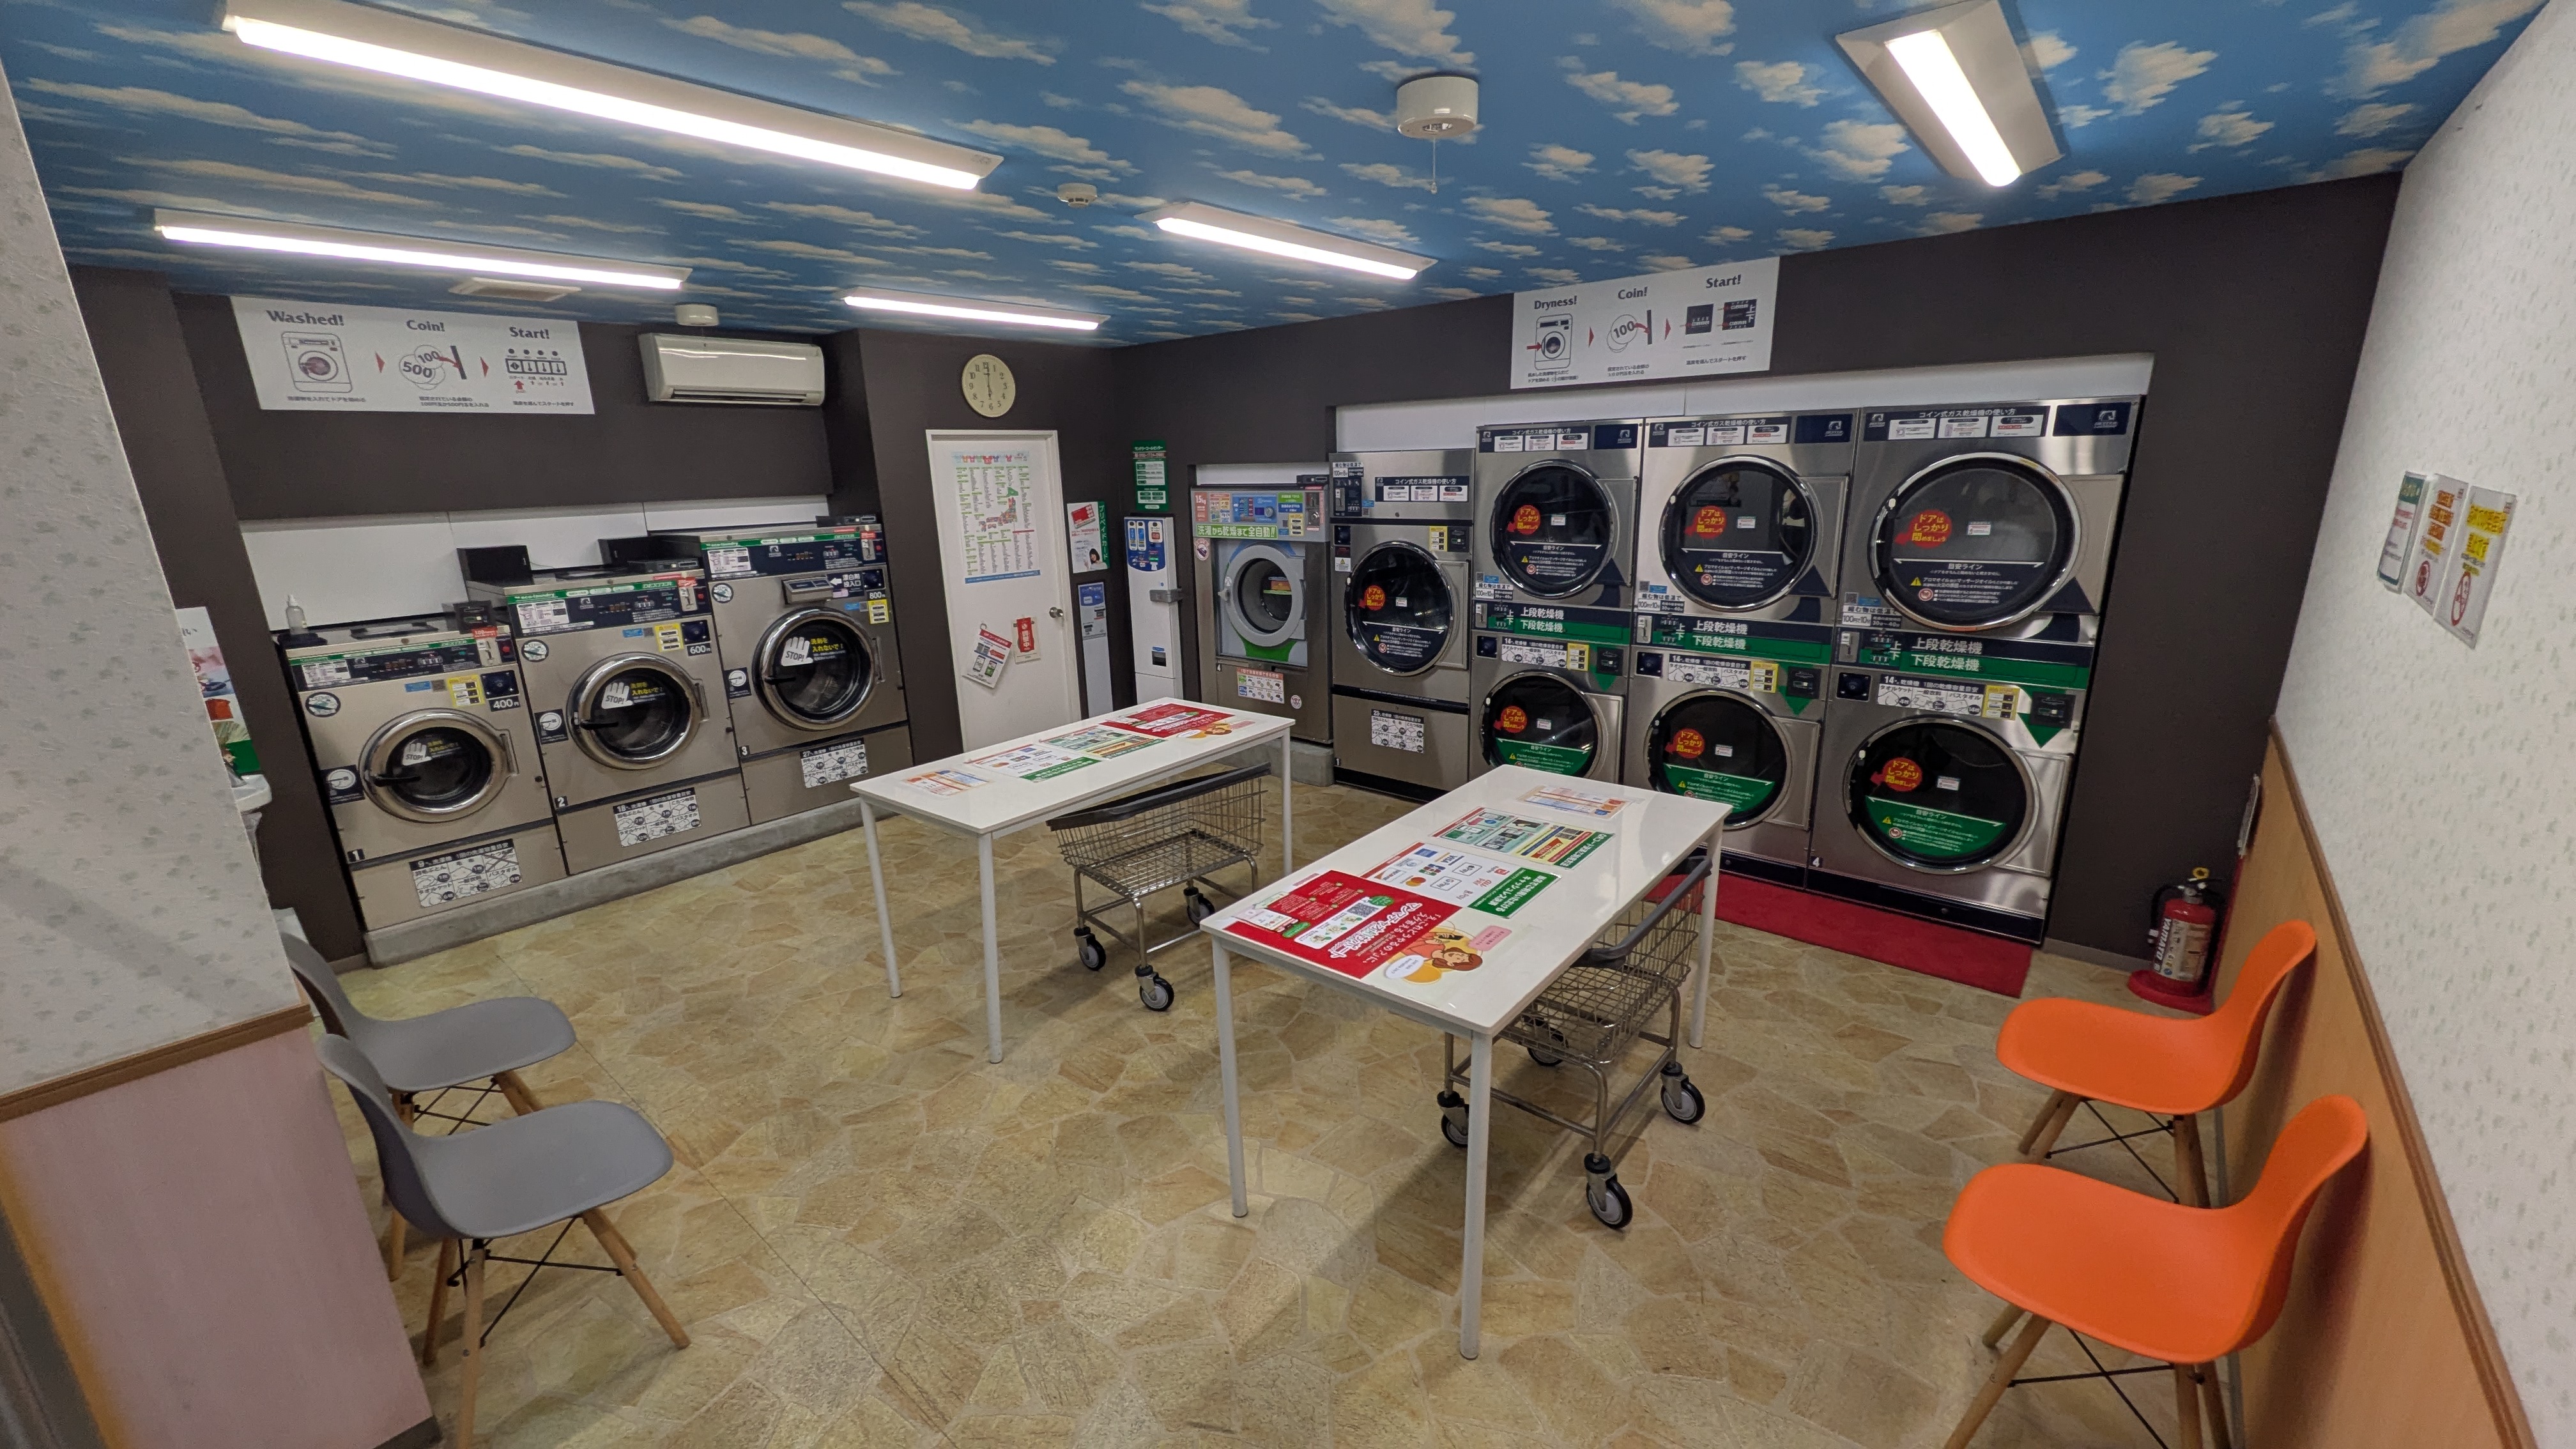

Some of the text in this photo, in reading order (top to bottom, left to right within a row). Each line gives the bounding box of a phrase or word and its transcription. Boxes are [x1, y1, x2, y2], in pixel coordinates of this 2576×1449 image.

[1706, 274, 1742, 289] Start!
[1618, 287, 1648, 300] Coin!
[1534, 296, 1577, 310] Dryness!
[266, 309, 344, 326] Washed!
[406, 319, 445, 333] Coin!
[1613, 321, 1636, 339] 100
[509, 326, 549, 340] Start!
[417, 351, 440, 364] 100
[402, 361, 433, 378] 500
[1698, 516, 1725, 525] しっかり
[1915, 523, 1949, 532] しっかり
[642, 581, 673, 589] DEXTER
[1521, 607, 1564, 620] 上段乾燥機
[1520, 620, 1563, 633] 下段乾燥機
[1693, 620, 1748, 635] 上段乾燥機
[1692, 635, 1746, 650] 下段乾燥機
[1890, 638, 1982, 655] 上 上段乾燥機
[785, 650, 804, 661] STOP!
[1890, 651, 1981, 671] 下 下段乾燥機
[605, 694, 624, 705] STOP!
[1678, 738, 1702, 747] しっかり
[742, 746, 748, 755] 3
[1888, 767, 1919, 779] しっかり
[557, 797, 565, 806] 2
[353, 851, 359, 860] 1
[1439, 854, 1458, 863] VISA
[1813, 857, 1820, 867] 4
[1485, 875, 1533, 906] キャッシュレス決済
